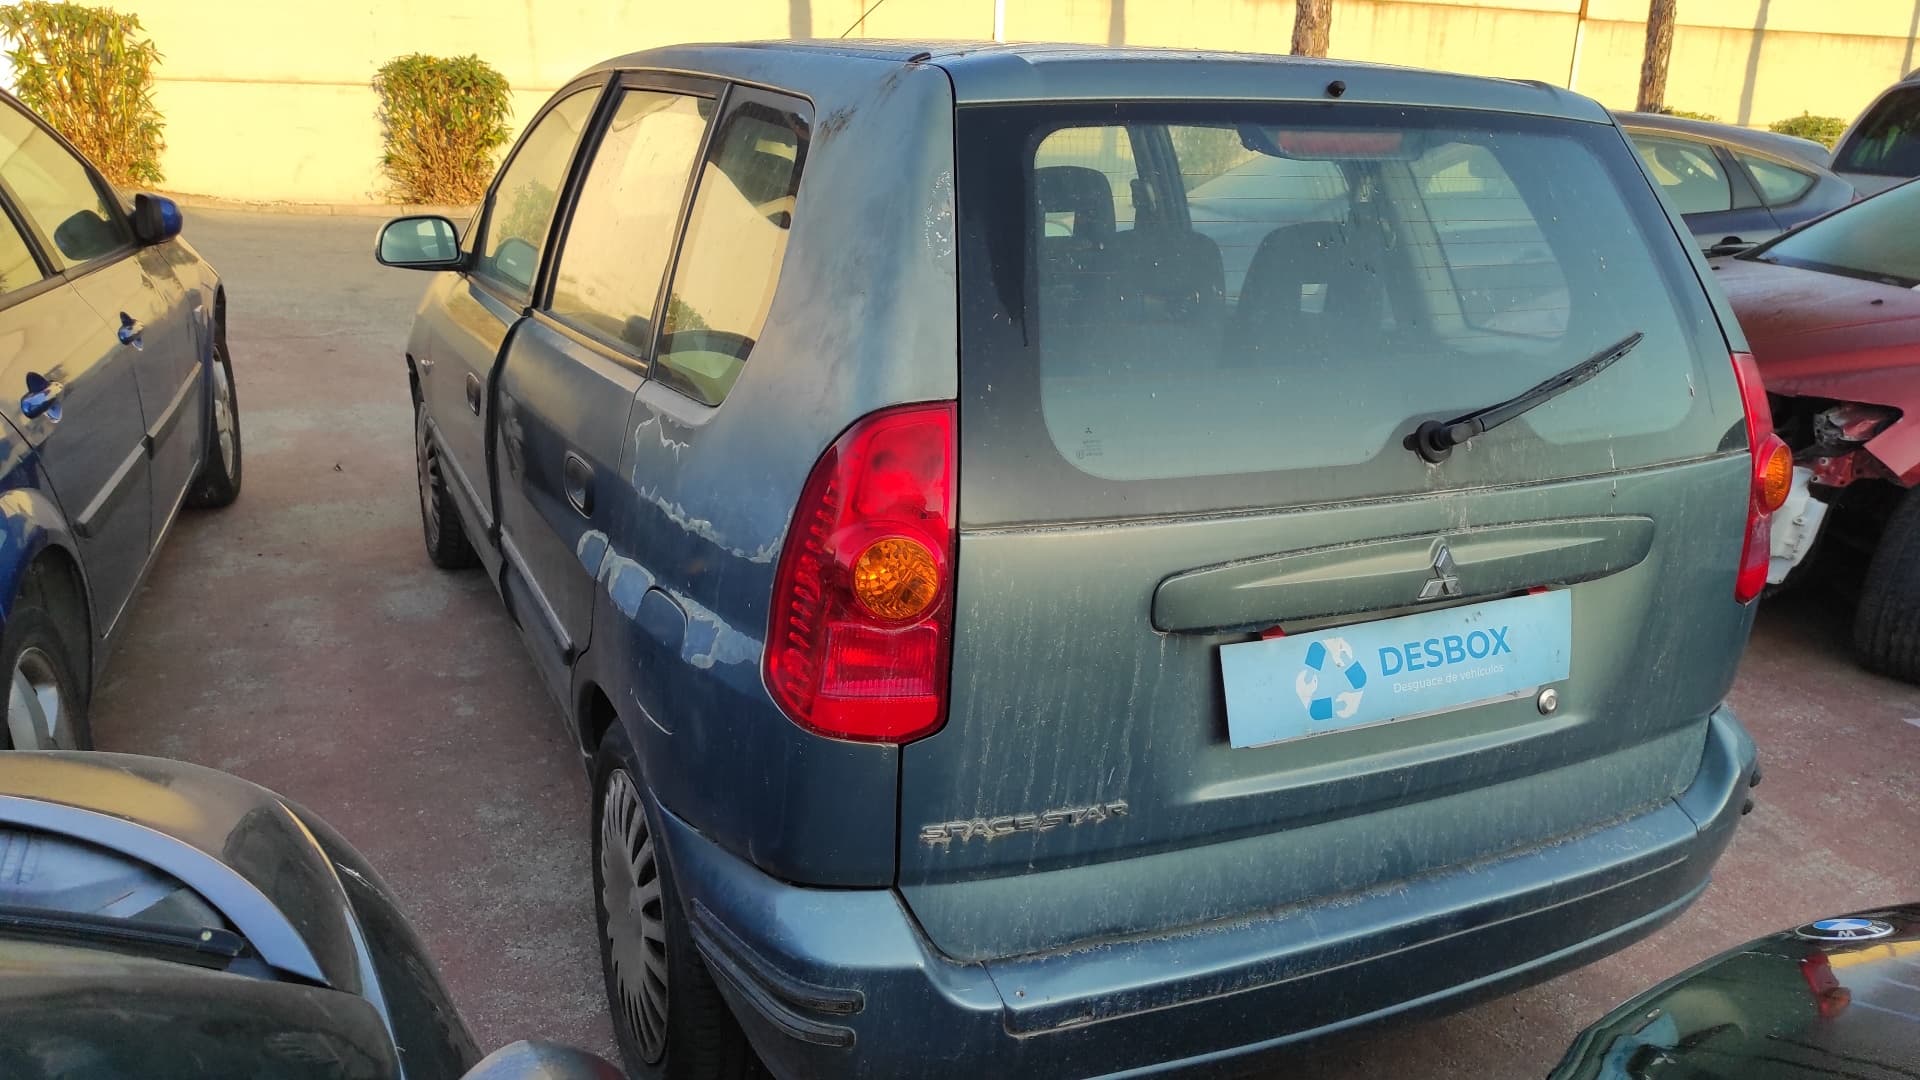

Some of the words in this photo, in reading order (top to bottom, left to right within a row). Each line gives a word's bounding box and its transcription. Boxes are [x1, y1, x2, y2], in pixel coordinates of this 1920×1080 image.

[1378, 626, 1512, 677] DESBOX
[1392, 676, 1443, 694] Desguace
[1445, 672, 1458, 684] de
[920, 815, 1038, 842] SPACE
[1040, 800, 1129, 831] STAR
